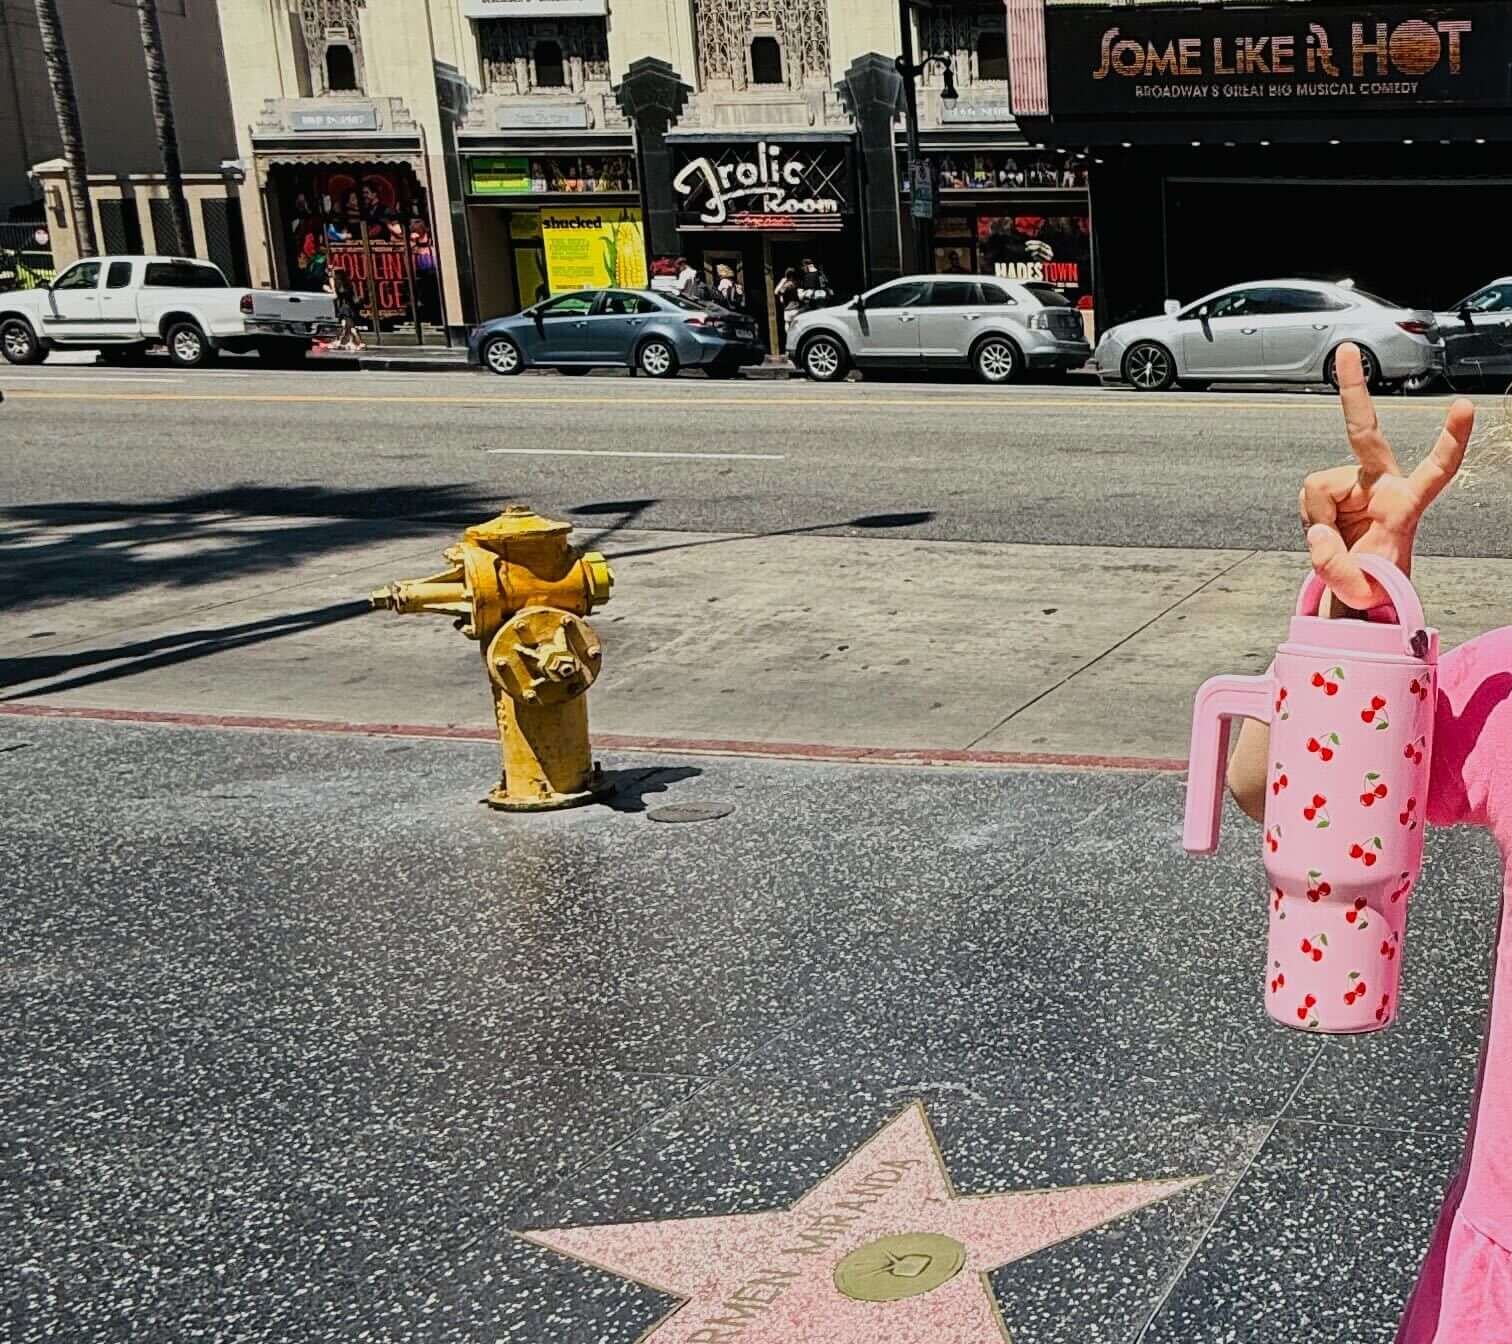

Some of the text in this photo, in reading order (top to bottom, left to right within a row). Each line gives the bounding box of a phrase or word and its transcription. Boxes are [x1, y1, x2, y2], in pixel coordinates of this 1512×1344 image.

[1093, 27, 1201, 80] SOME
[1351, 19, 1472, 77] HOT
[1223, 85, 1264, 97] GREAT
[1269, 85, 1292, 96] BIG
[1296, 83, 1357, 97] MUSICAL
[1360, 82, 1418, 95] COMEDY
[673, 141, 805, 223] Frolic
[763, 187, 837, 212] Room
[543, 216, 602, 229] shucked
[780, 1159, 922, 1256] MIRANDA
